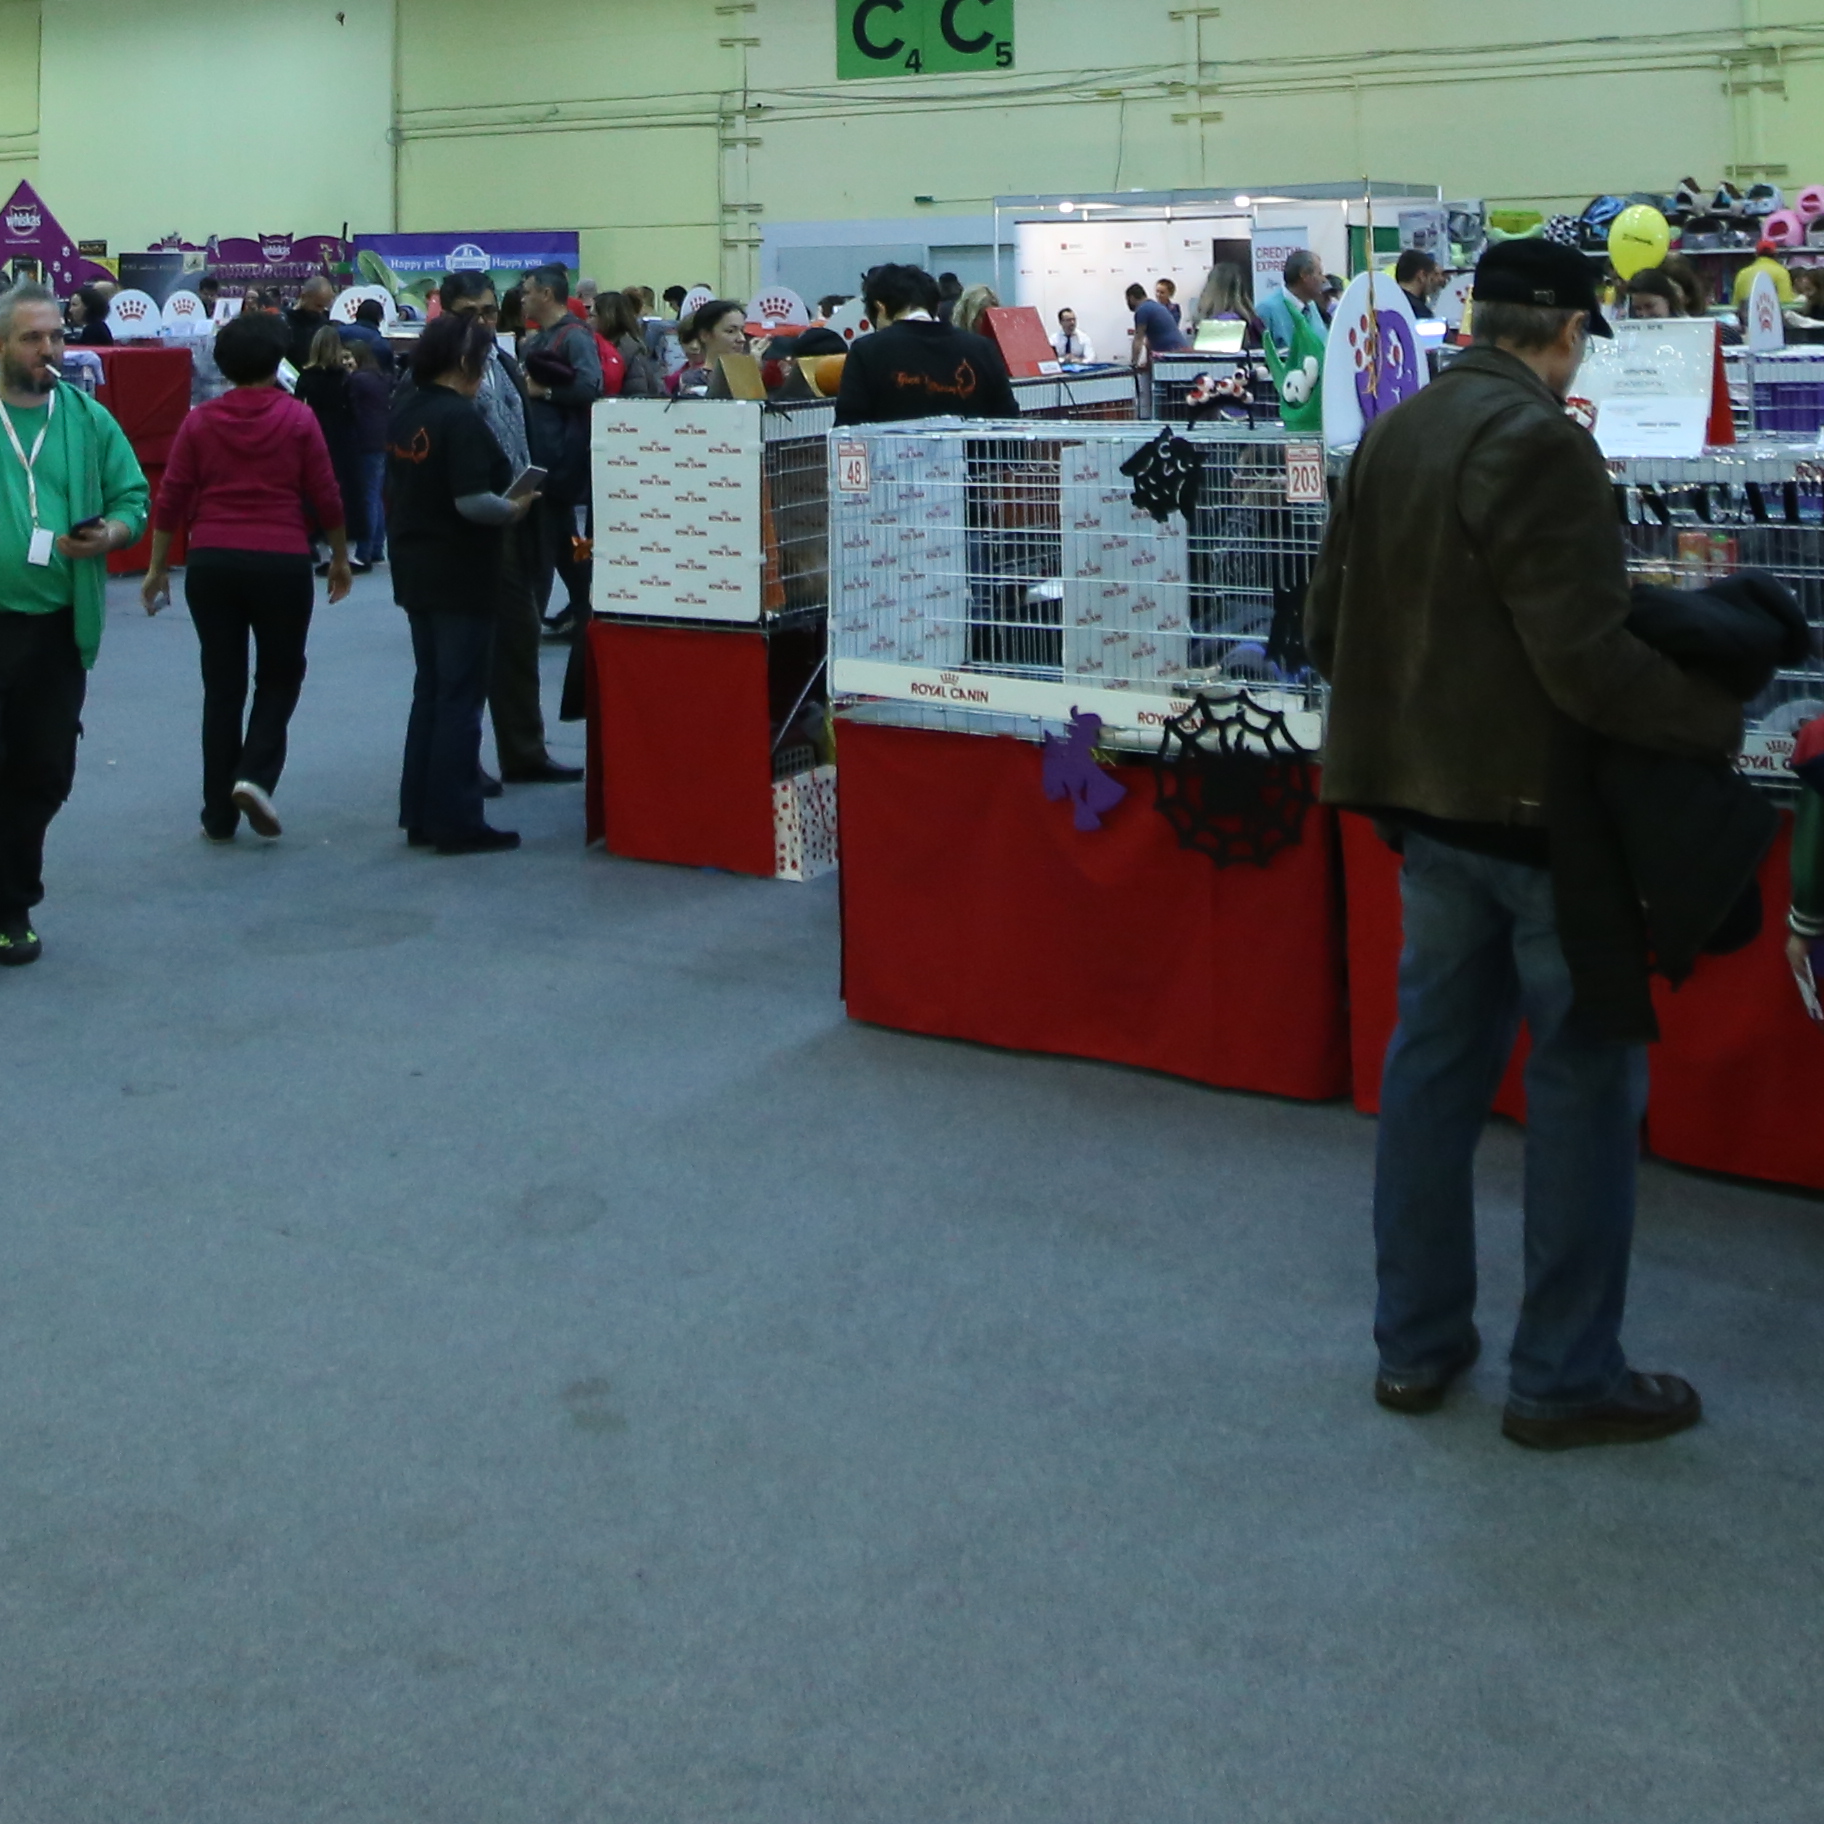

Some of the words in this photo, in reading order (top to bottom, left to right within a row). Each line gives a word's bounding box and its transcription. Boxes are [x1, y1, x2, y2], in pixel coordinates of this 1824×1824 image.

[390, 259, 421, 270] Happy
[492, 258, 523, 268] Happy
[847, 460, 862, 485] 48
[1293, 466, 1319, 492] 203
[911, 682, 946, 697] ROYAL
[950, 687, 989, 703] CANIN
[1737, 755, 1778, 771] OYAL
